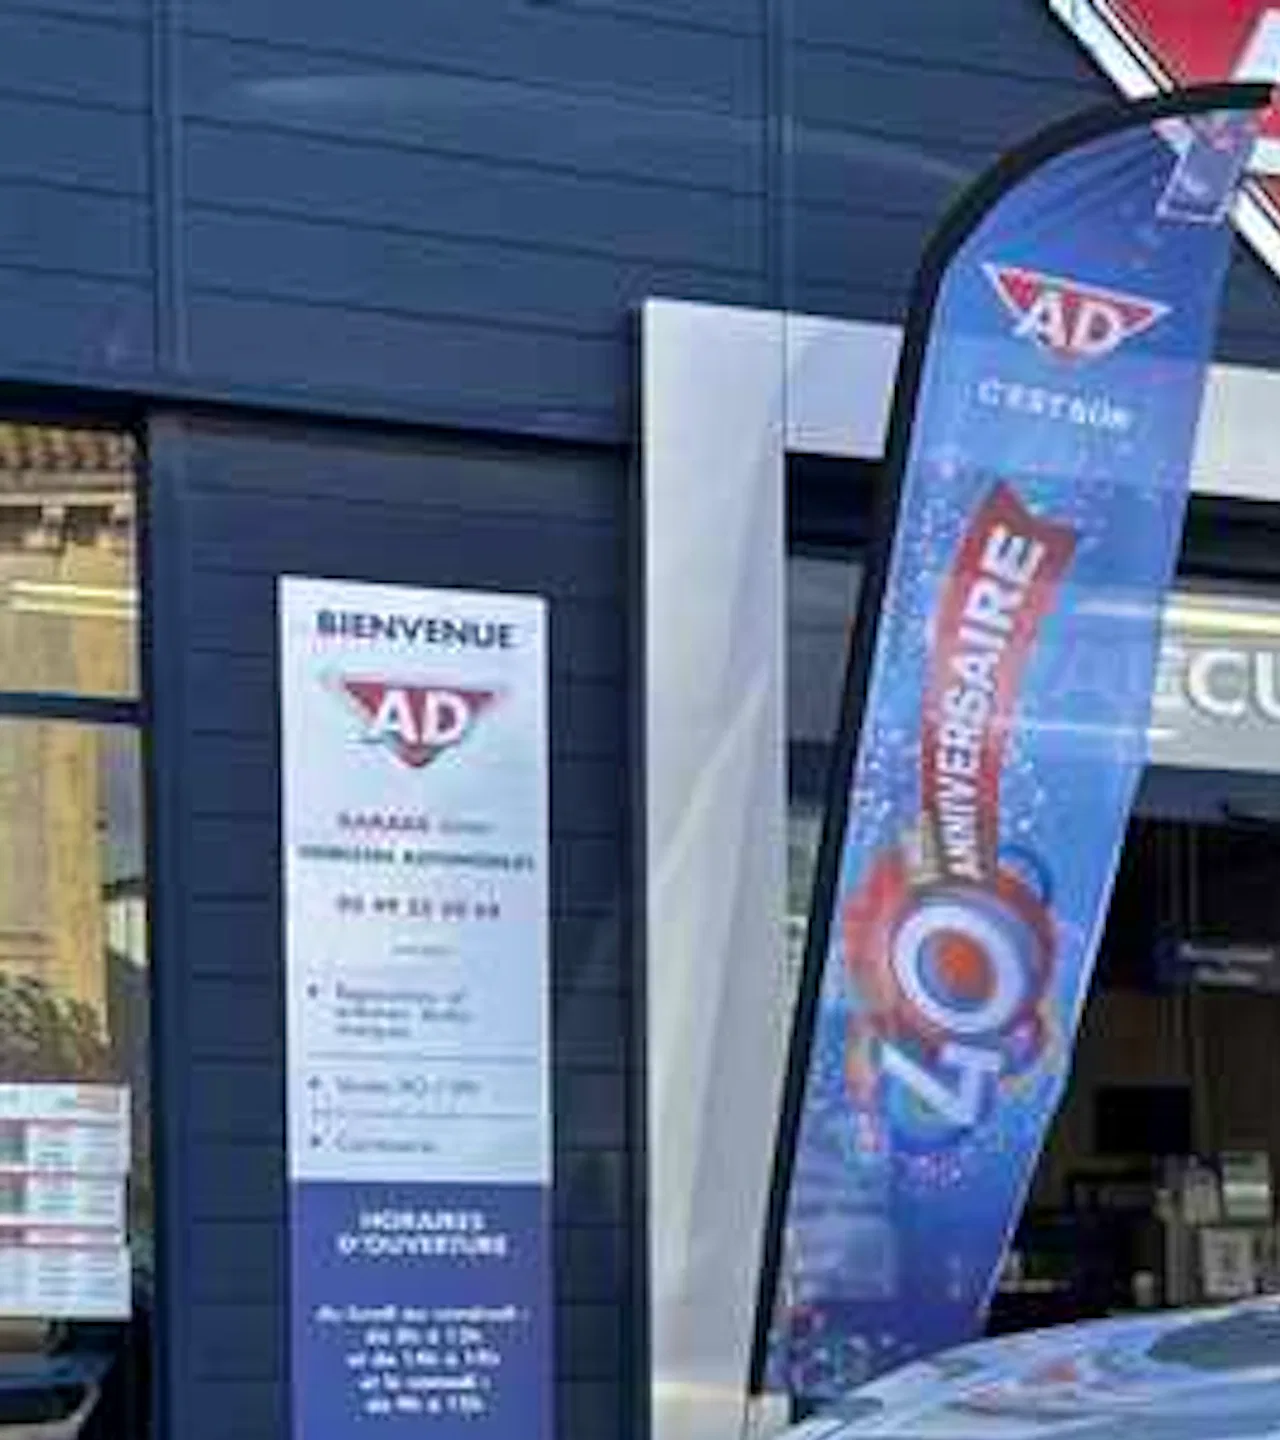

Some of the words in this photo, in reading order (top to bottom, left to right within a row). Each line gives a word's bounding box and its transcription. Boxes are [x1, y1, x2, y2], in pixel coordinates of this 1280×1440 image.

[1012, 288, 1122, 358] AD
[316, 609, 517, 649] BIENVENUE
[374, 688, 470, 744] AD
[934, 524, 1046, 880] ANNIVERSAIRE
[879, 904, 1026, 1126] 40
